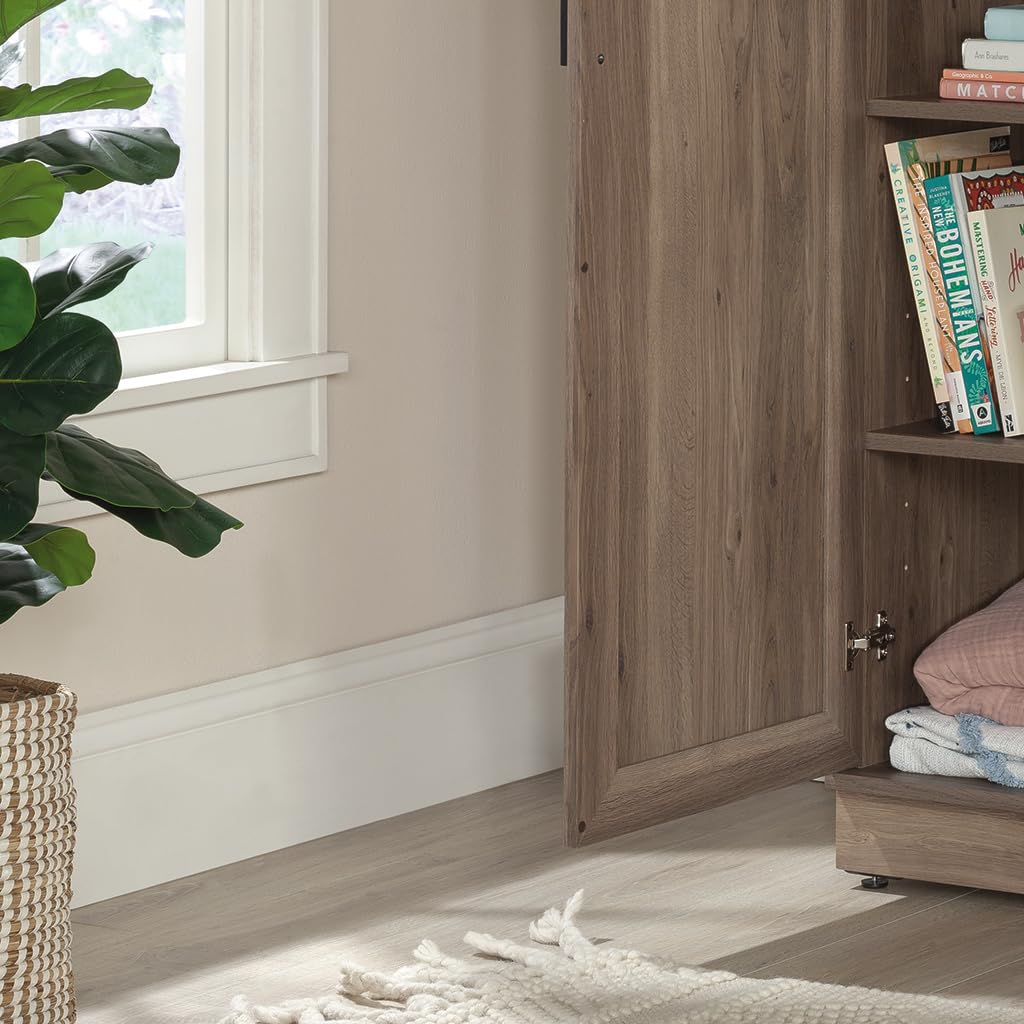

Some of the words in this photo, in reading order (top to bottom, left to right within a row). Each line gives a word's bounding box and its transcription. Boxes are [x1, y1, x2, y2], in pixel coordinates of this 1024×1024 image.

[975, 51, 984, 59] Ann
[912, 177, 924, 196] THE
[917, 203, 934, 255] INSPIRED
[932, 206, 945, 227] NEW
[944, 206, 956, 226] THE
[894, 179, 913, 244] CREATIVE
[909, 254, 927, 313] ORIGAMI
[929, 261, 949, 336] HOUSEPLANT
[936, 228, 982, 364] BOHEMIANS
[972, 222, 988, 277] MASTERING
[985, 304, 998, 349] Lettering
